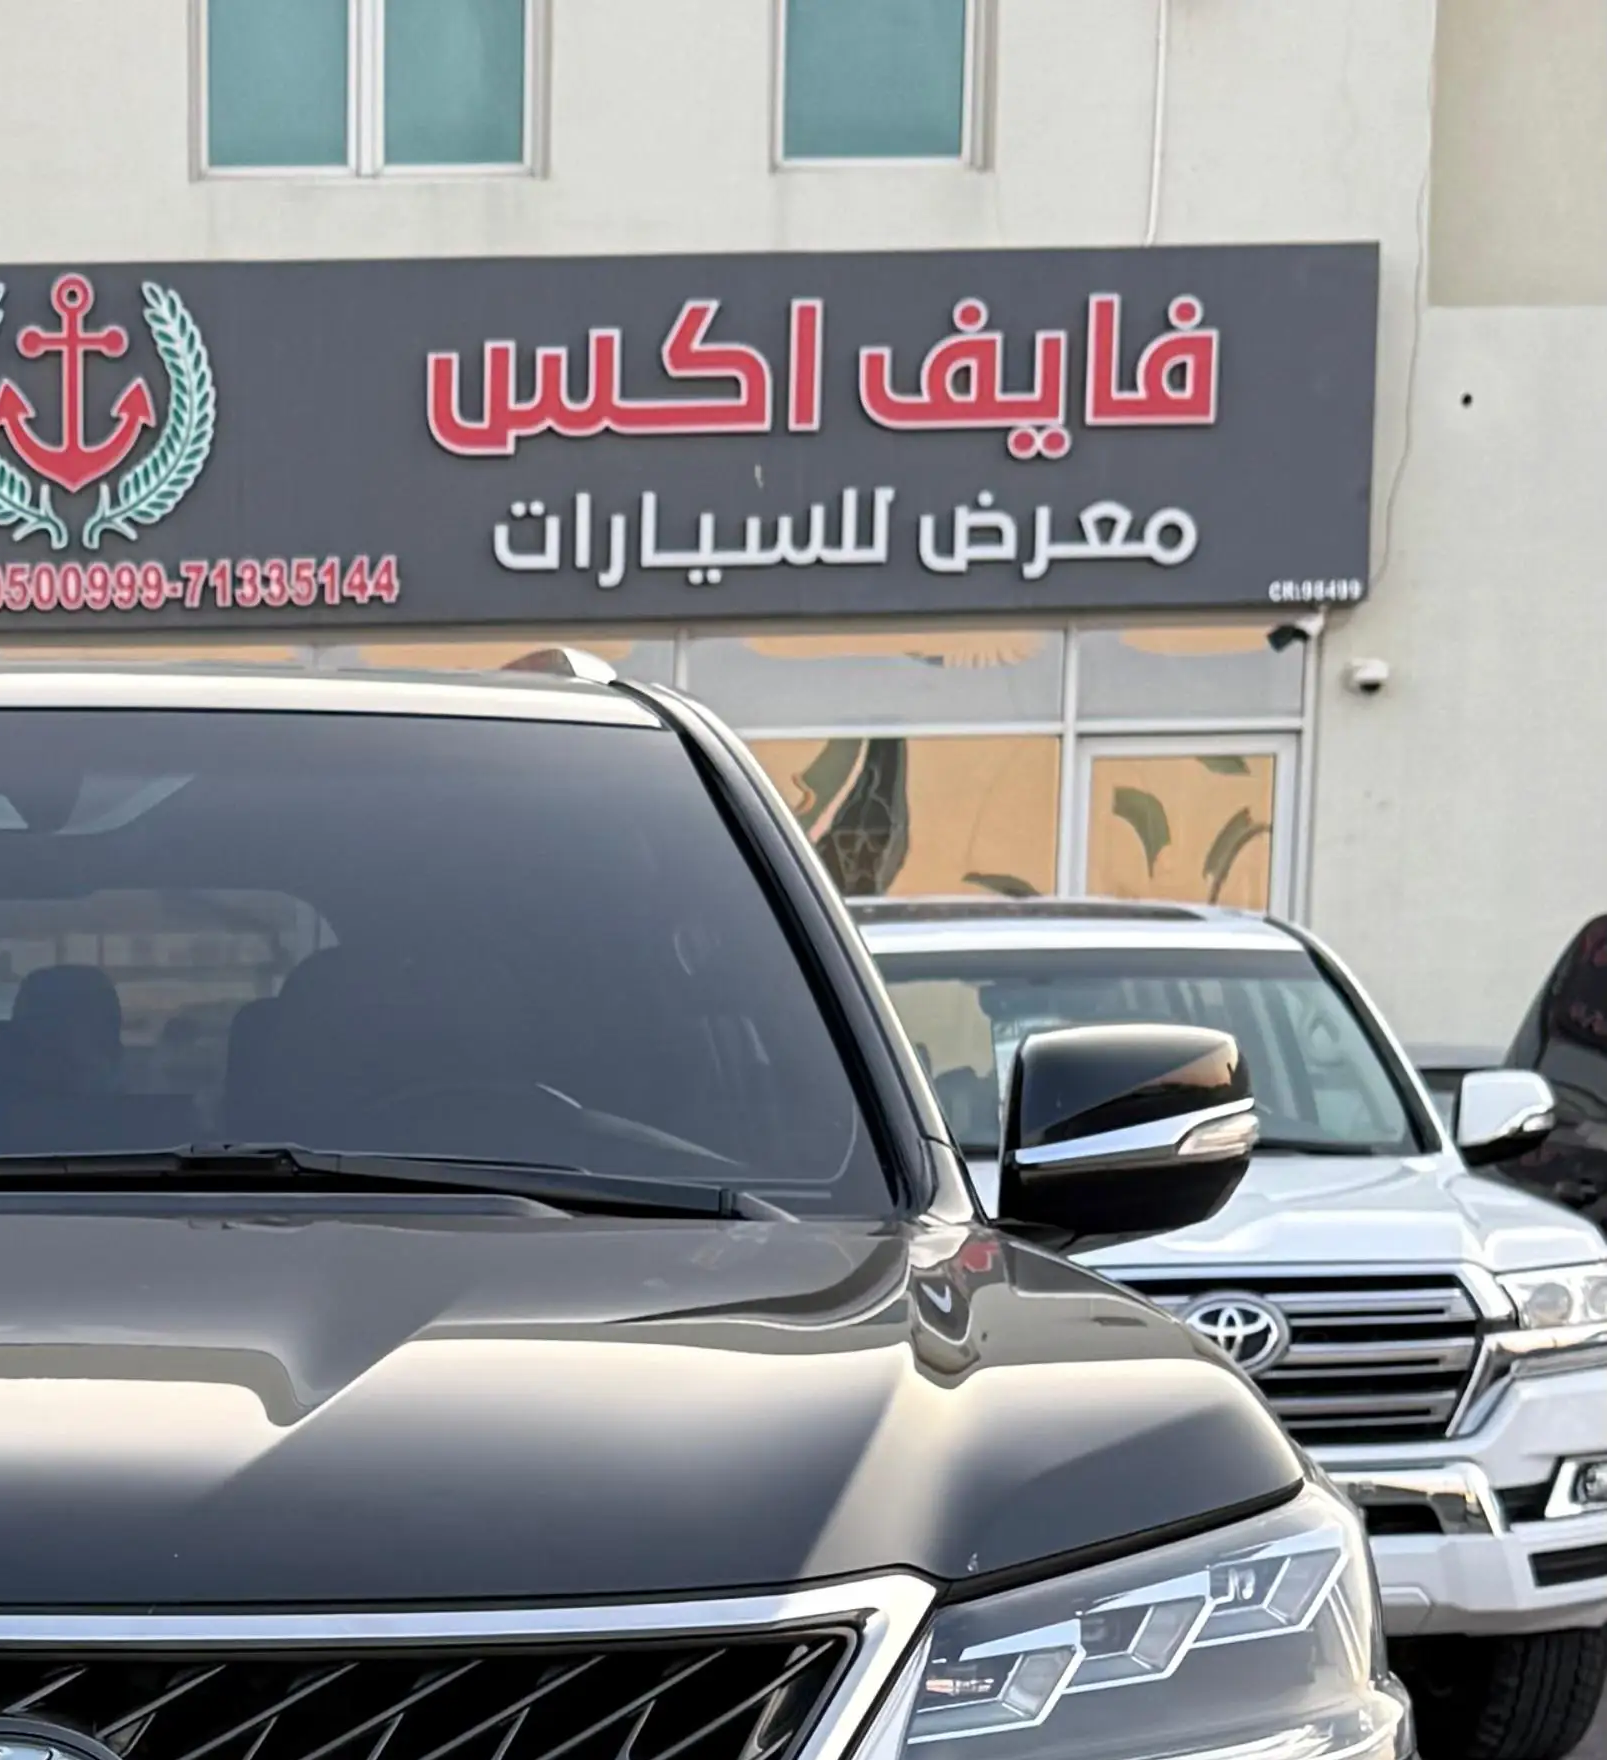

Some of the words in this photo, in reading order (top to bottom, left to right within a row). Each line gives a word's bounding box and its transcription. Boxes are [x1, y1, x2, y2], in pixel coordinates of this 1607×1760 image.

[427, 298, 823, 456] اكس
[859, 293, 1219, 459] فايف
[494, 486, 895, 588] للسيارات
[919, 489, 1197, 580] معرض
